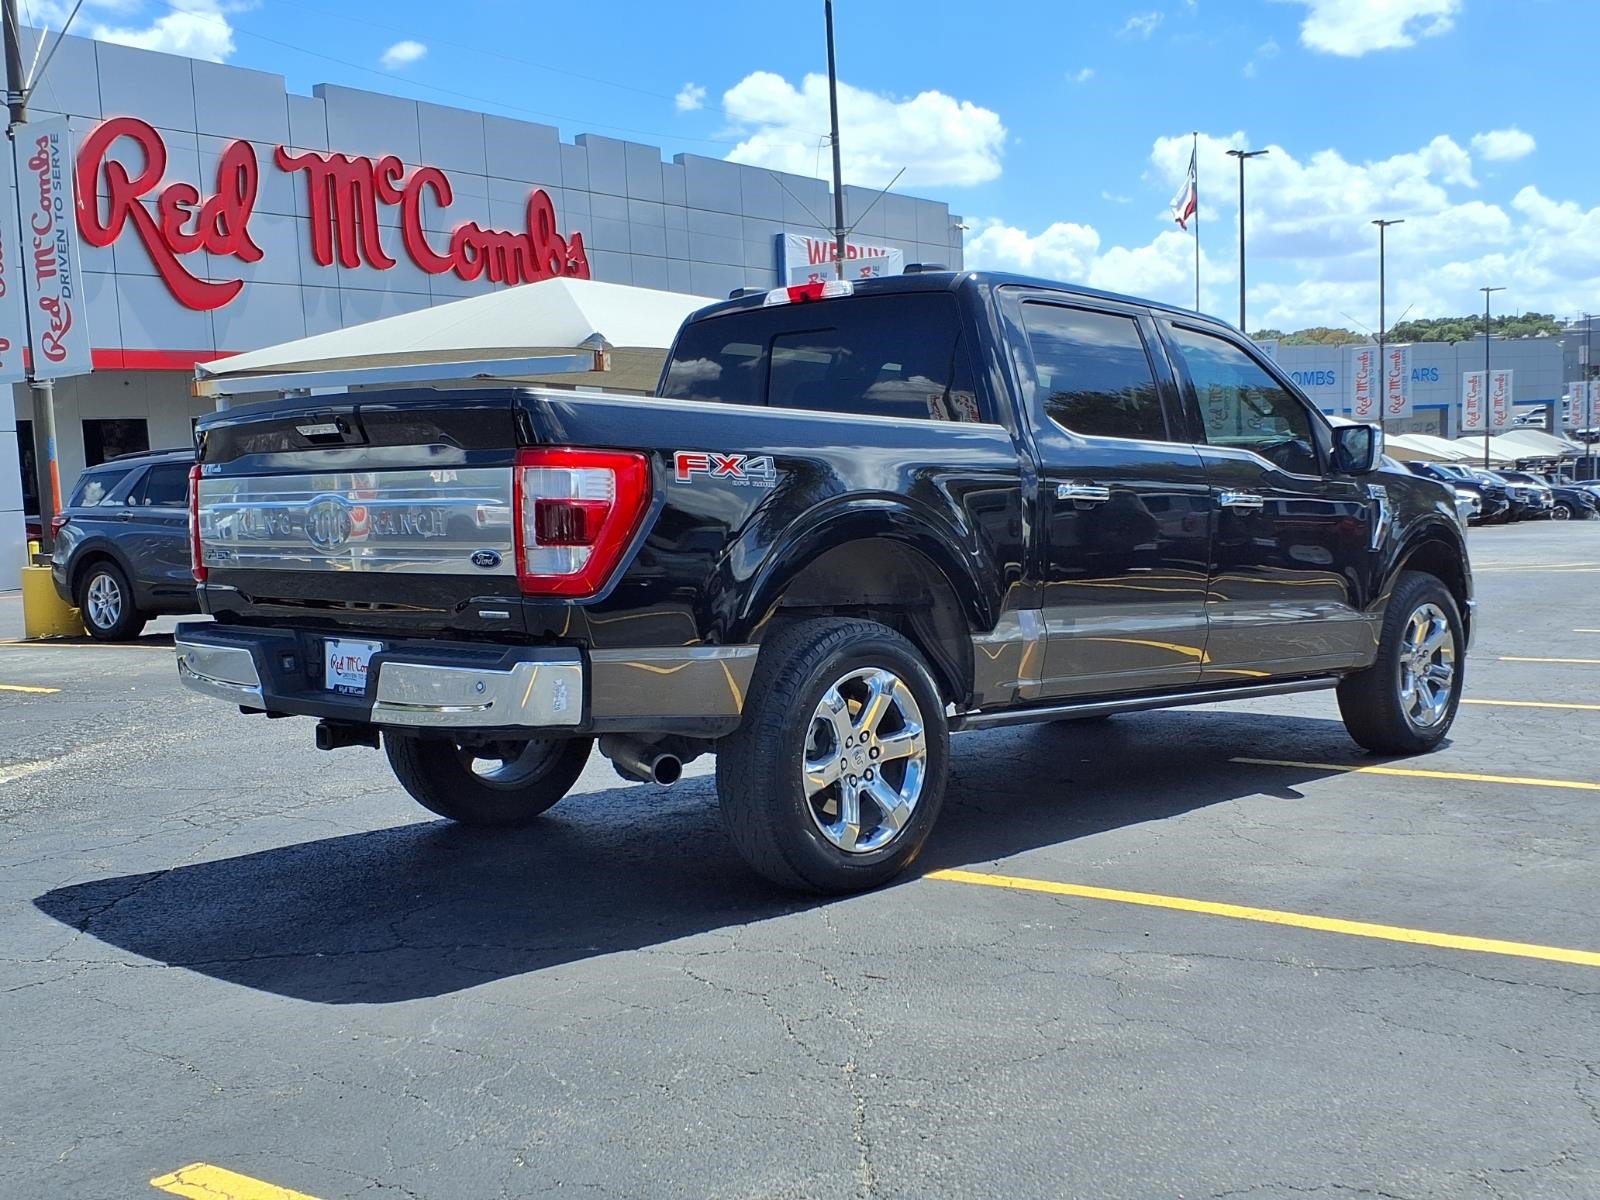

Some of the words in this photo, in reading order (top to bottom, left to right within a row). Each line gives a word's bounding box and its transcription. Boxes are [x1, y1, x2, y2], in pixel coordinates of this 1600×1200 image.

[50, 132, 63, 191] SERVE
[28, 134, 58, 291] McCombs
[54, 197, 64, 223] TO
[75, 116, 264, 311] Red
[275, 145, 591, 286] McCombs
[57, 229, 72, 299] DRIVEN
[38, 294, 71, 362] Red
[1356, 396, 1373, 415] Red
[673, 450, 777, 484] FX4
[330, 653, 345, 676] Red
